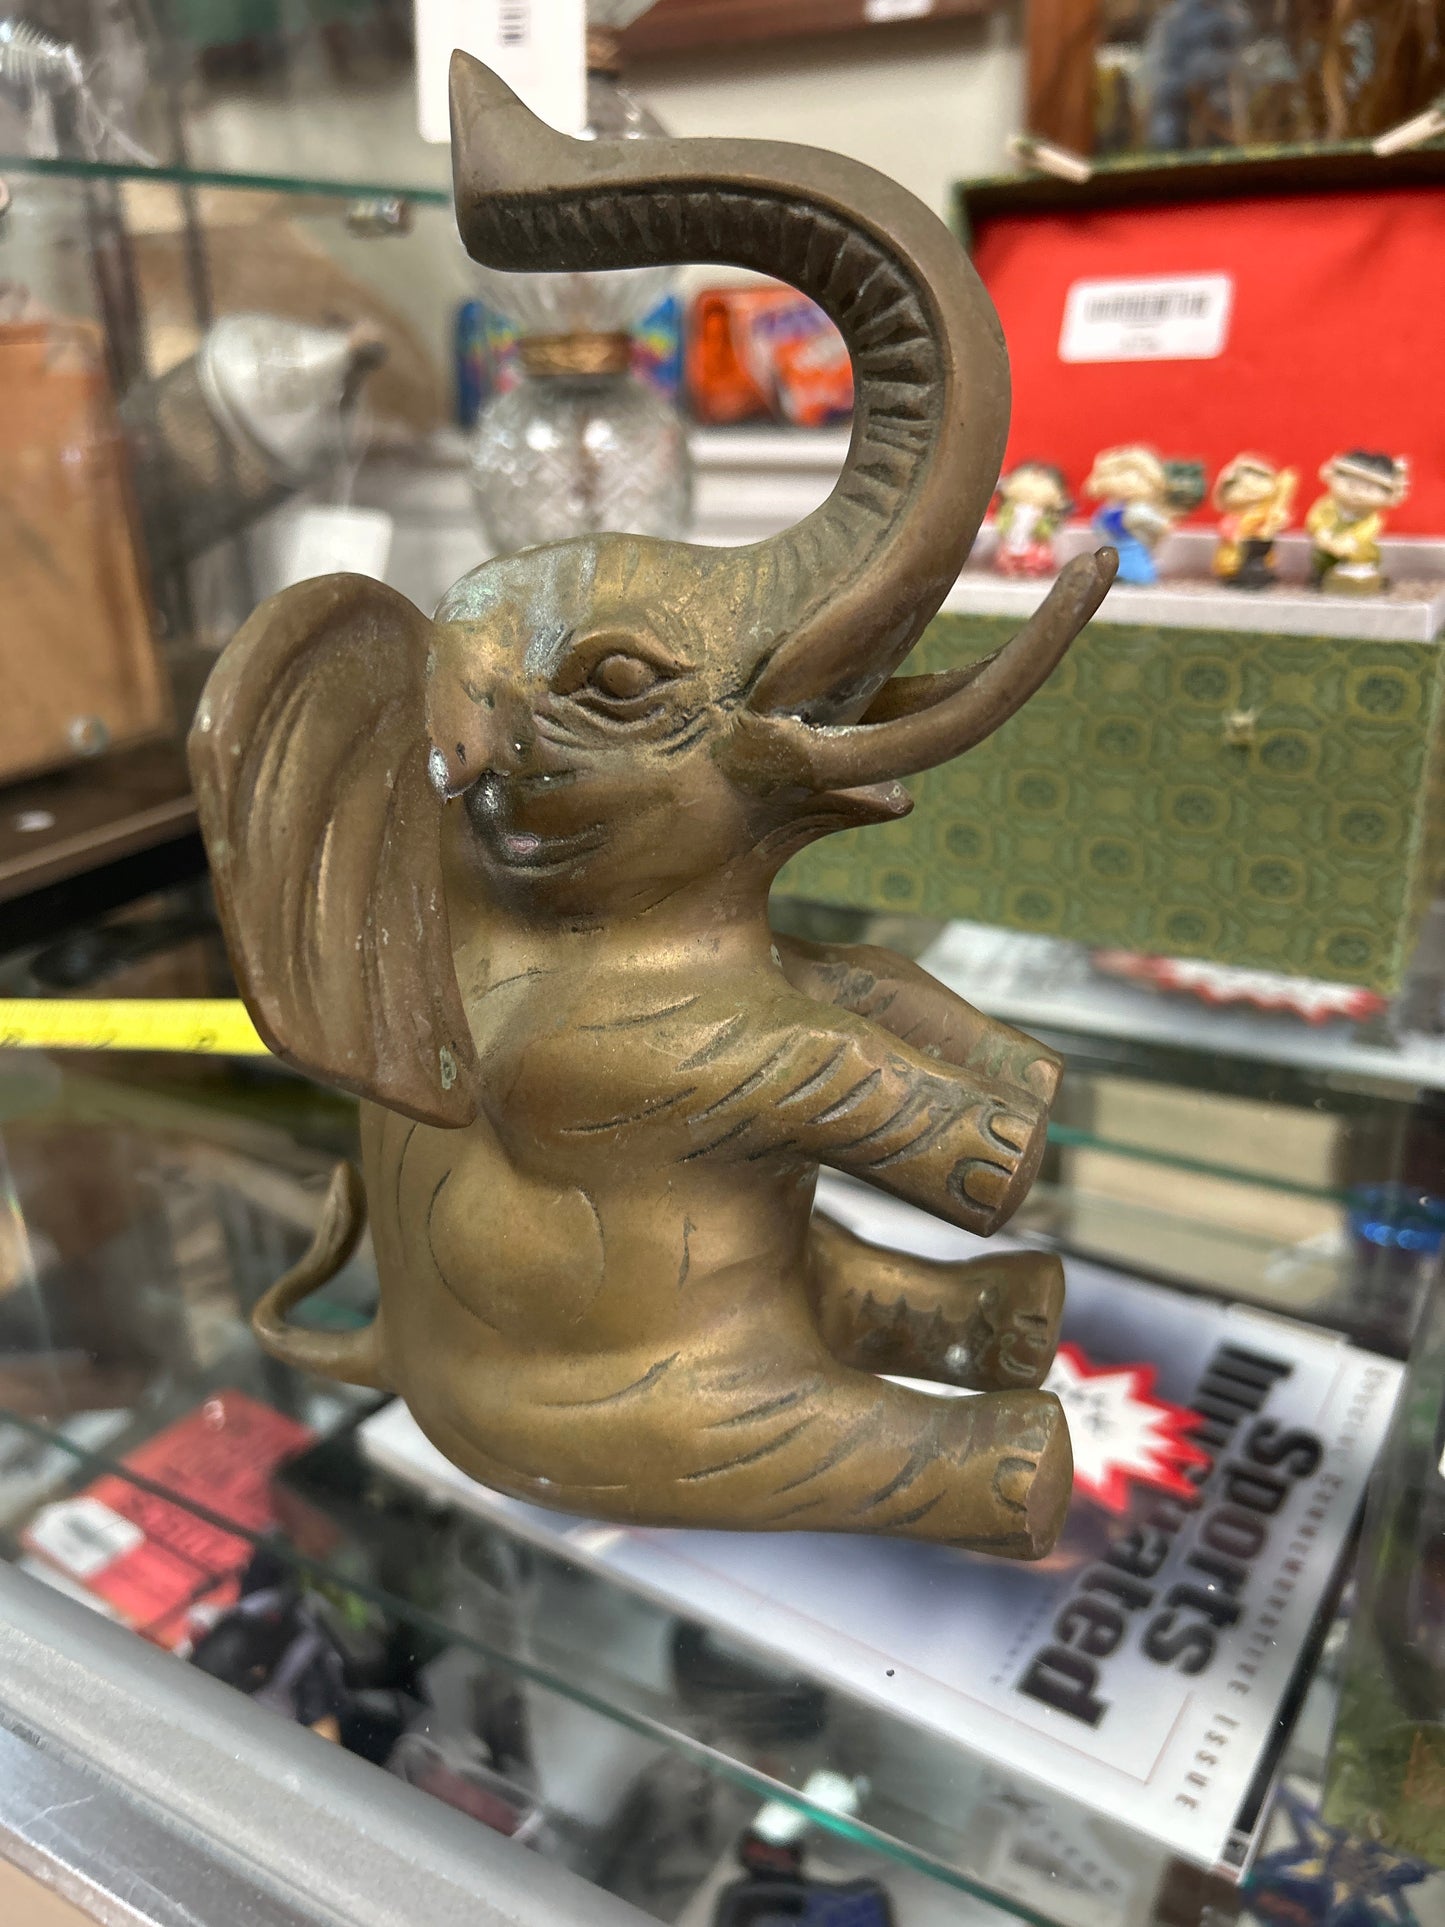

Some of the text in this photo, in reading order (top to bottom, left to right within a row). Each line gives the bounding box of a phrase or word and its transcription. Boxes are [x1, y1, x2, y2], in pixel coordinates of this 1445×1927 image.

[1014, 1341, 1295, 1729] Illurated
[1141, 1418, 1322, 1676] Sports
[1175, 1711, 1240, 1811] ISSUE
